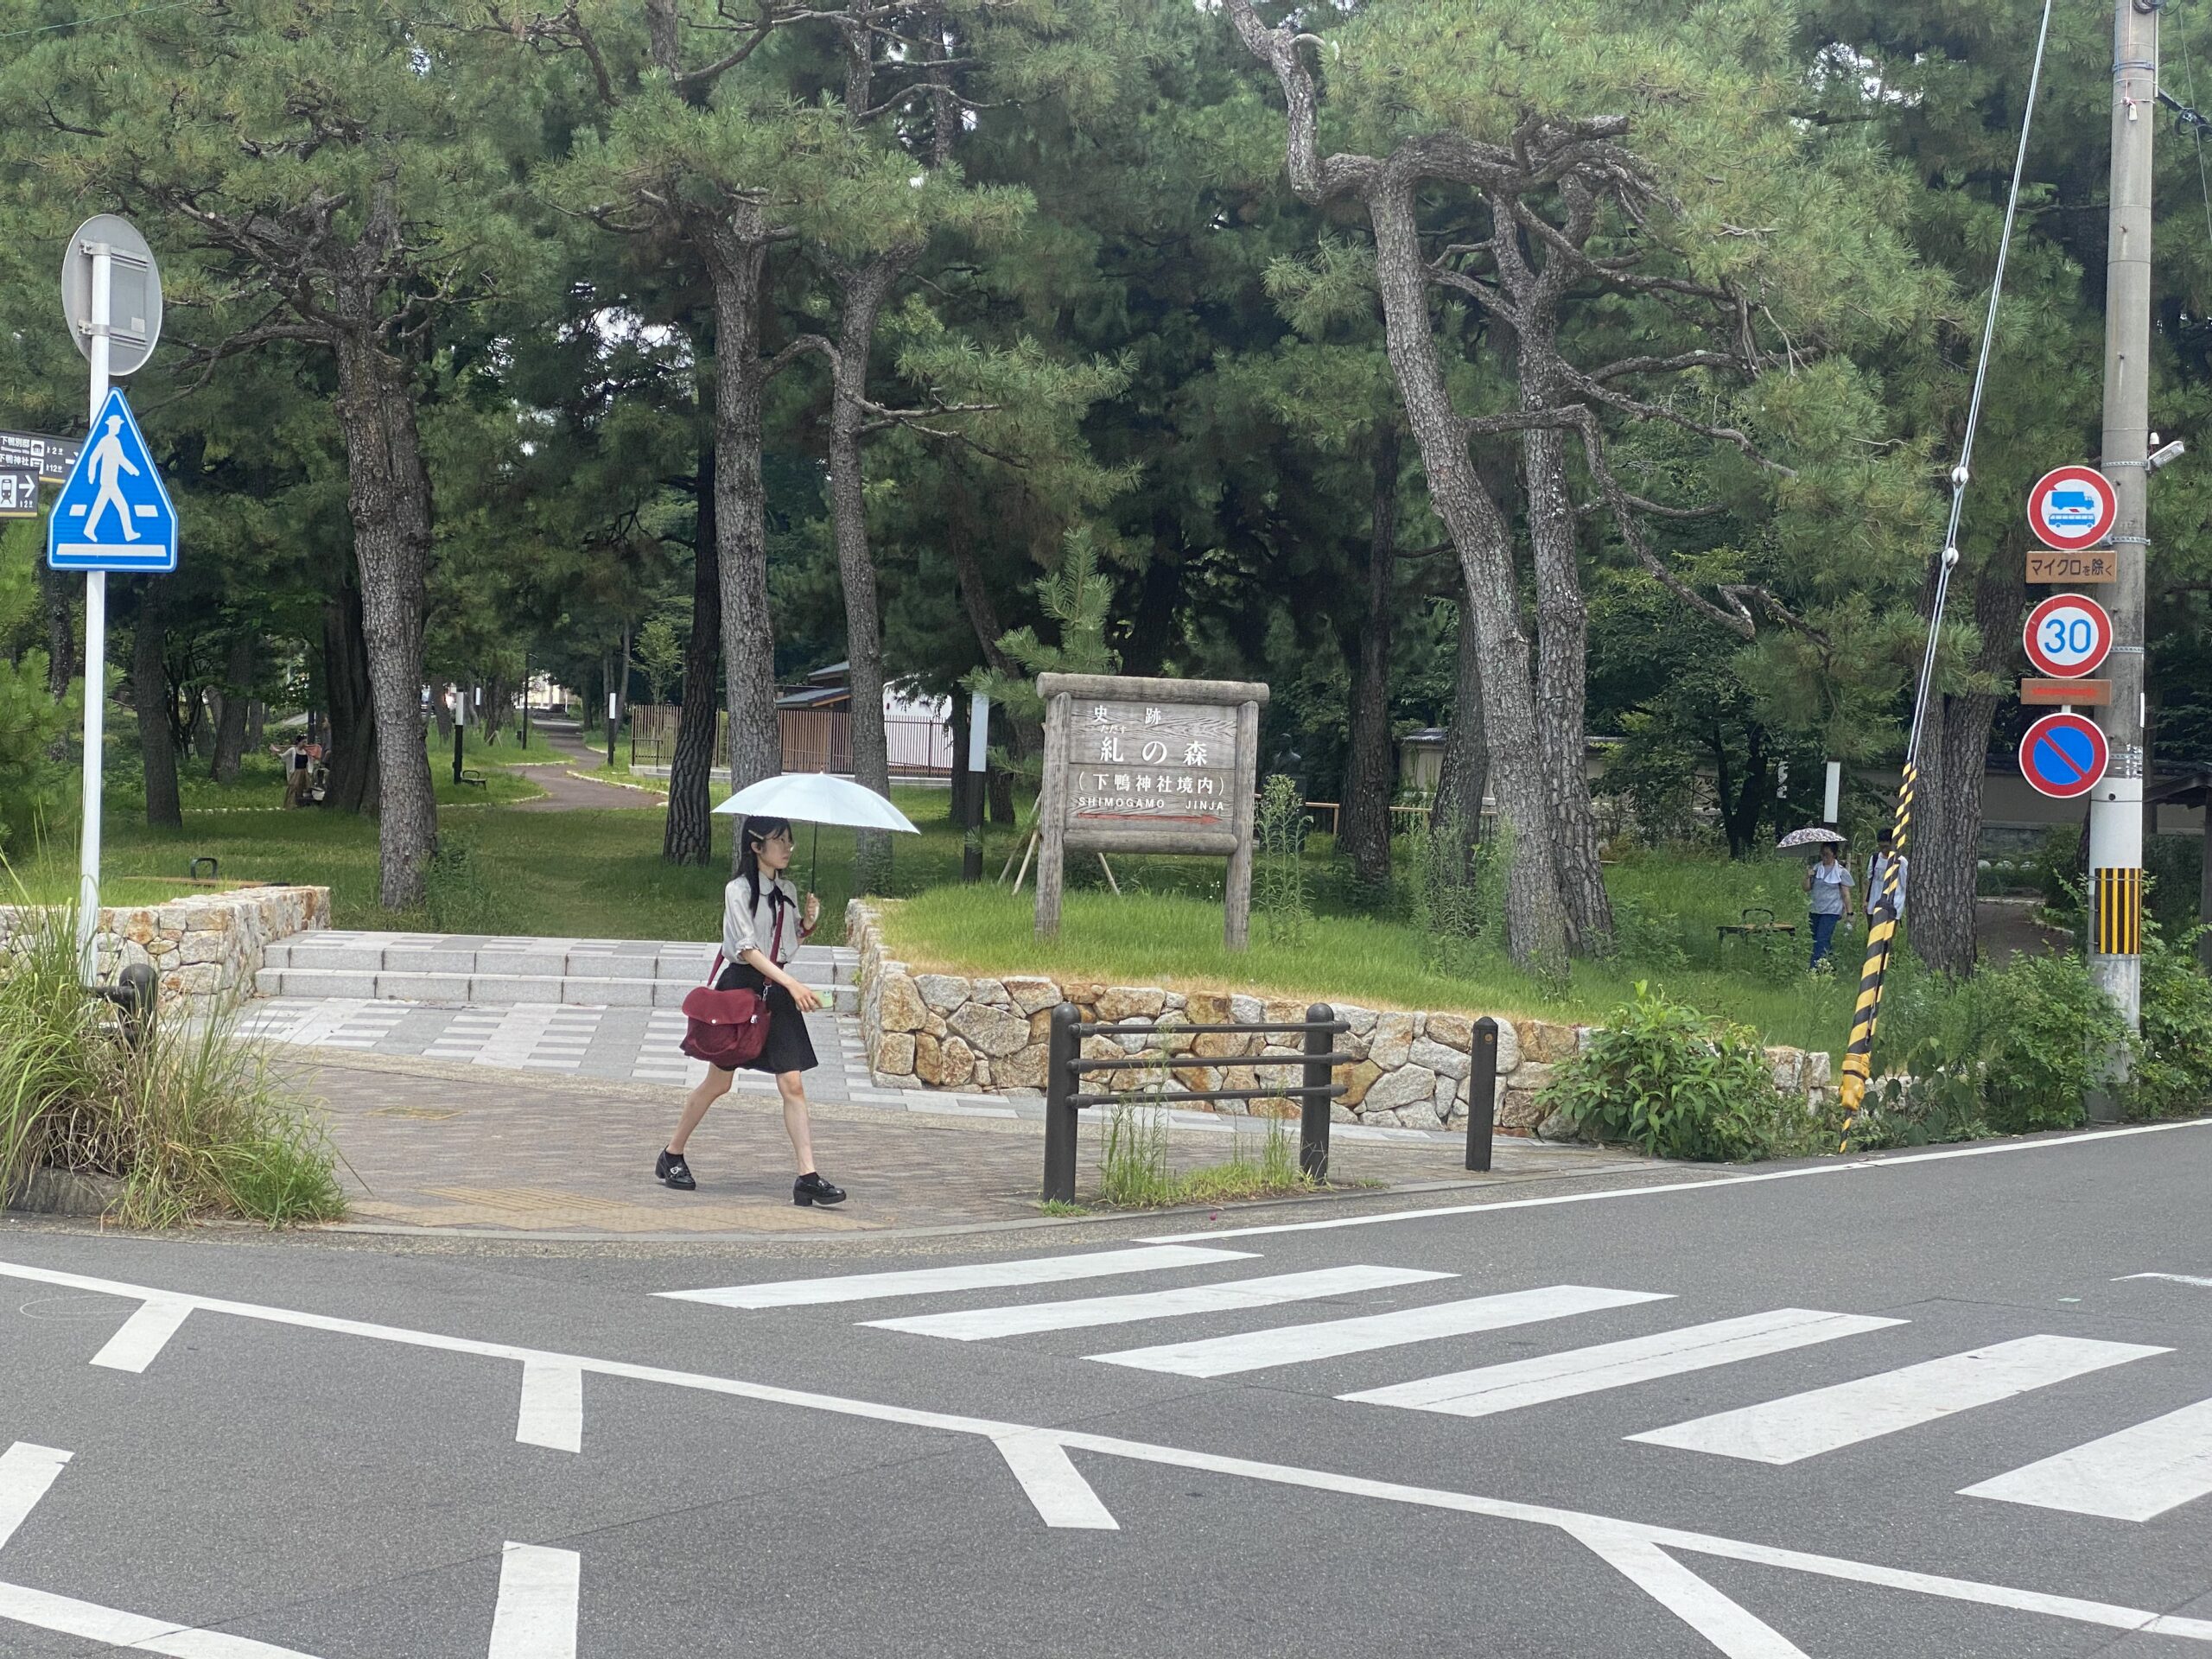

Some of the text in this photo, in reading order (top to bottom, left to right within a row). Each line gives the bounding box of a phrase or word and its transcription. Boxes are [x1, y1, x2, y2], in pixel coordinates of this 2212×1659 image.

[2031, 558, 2113, 576] マイクロを除く
[2044, 619, 2091, 653] 30
[1101, 725, 1127, 734] ただす
[1100, 736, 1208, 766] 糺の森
[1079, 772, 1224, 796] (下鴨神社境内)
[1078, 797, 1224, 810] SHIMOGAMO JINJA
